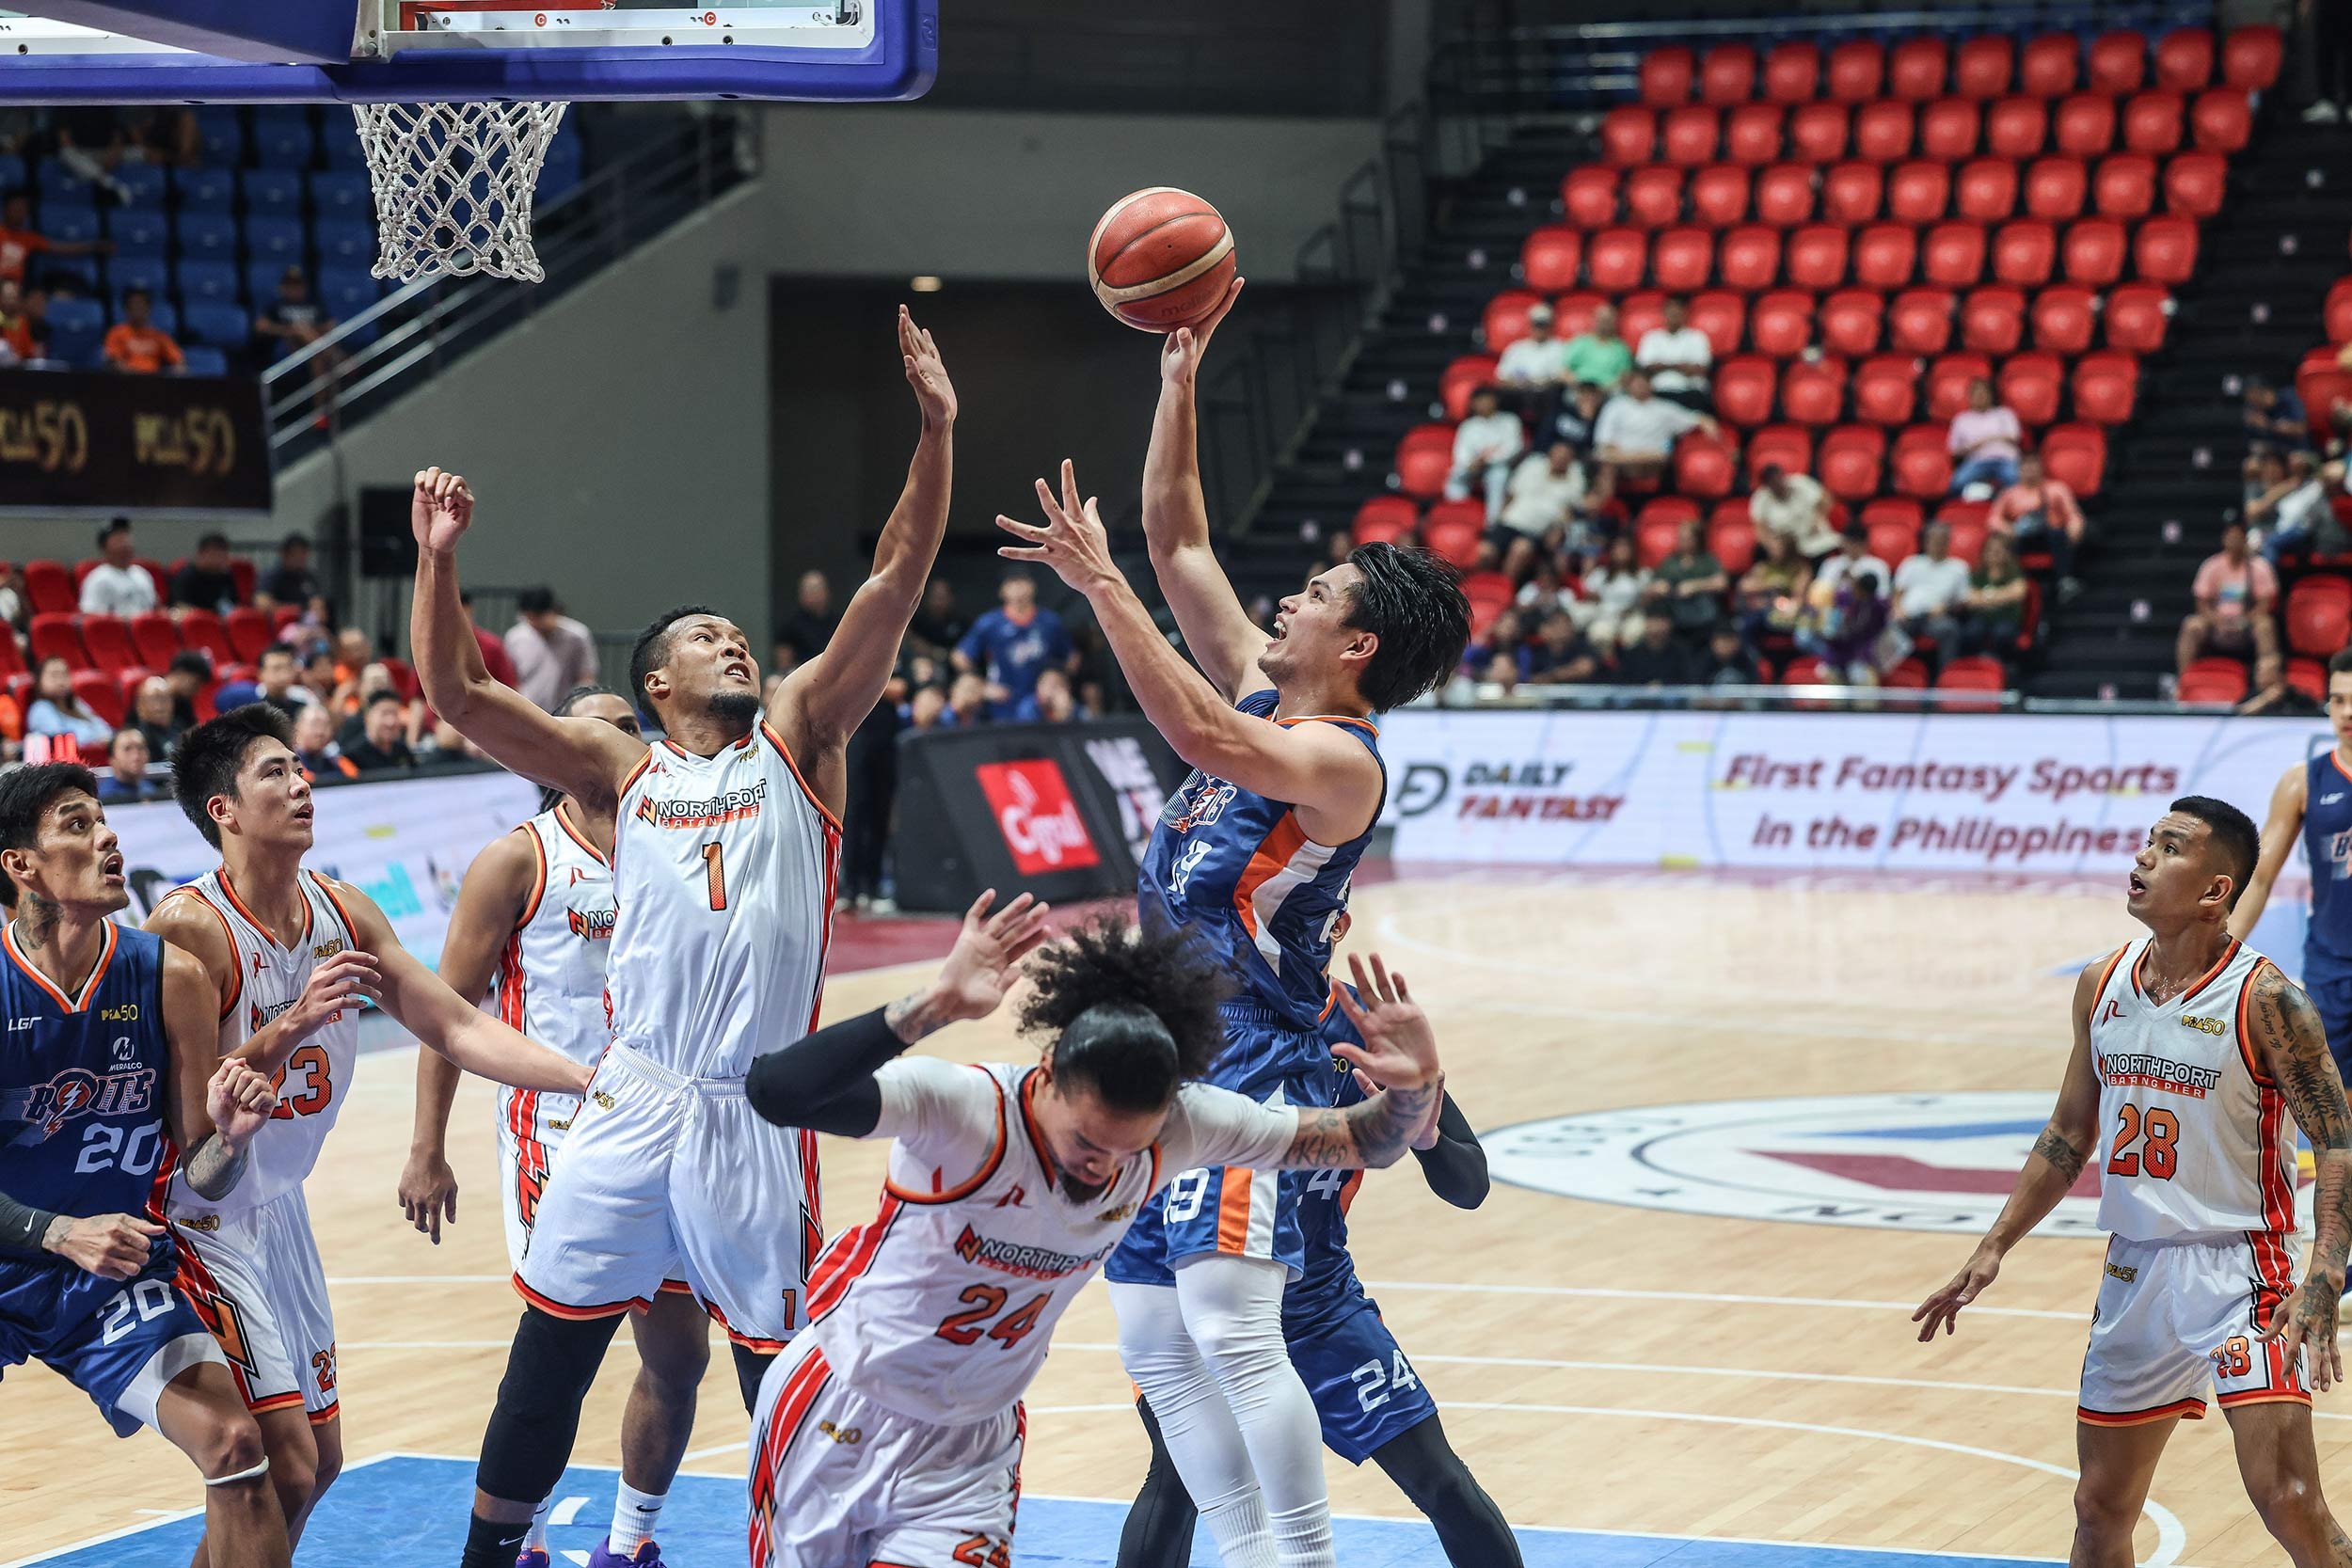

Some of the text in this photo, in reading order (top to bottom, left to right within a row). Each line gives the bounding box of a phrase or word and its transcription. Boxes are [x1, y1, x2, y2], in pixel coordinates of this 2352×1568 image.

[1464, 761, 1577, 787] DAILY
[1724, 753, 2179, 804] First Fantasy Sports
[1456, 795, 1626, 823] FANTASY
[1753, 813, 2144, 862] in the Philippines
[702, 842, 727, 911] 1
[108, 1062, 142, 1072] MERALCO
[2106, 1053, 2222, 1090] NORTHPORT
[2164, 1082, 2204, 1100] PIER
[74, 1118, 163, 1177] 20
[2107, 1102, 2181, 1181] 28
[97, 1278, 176, 1346] 20
[782, 1289, 797, 1330] 1
[934, 1282, 1054, 1350] 24
[1351, 1349, 1418, 1413] 24
